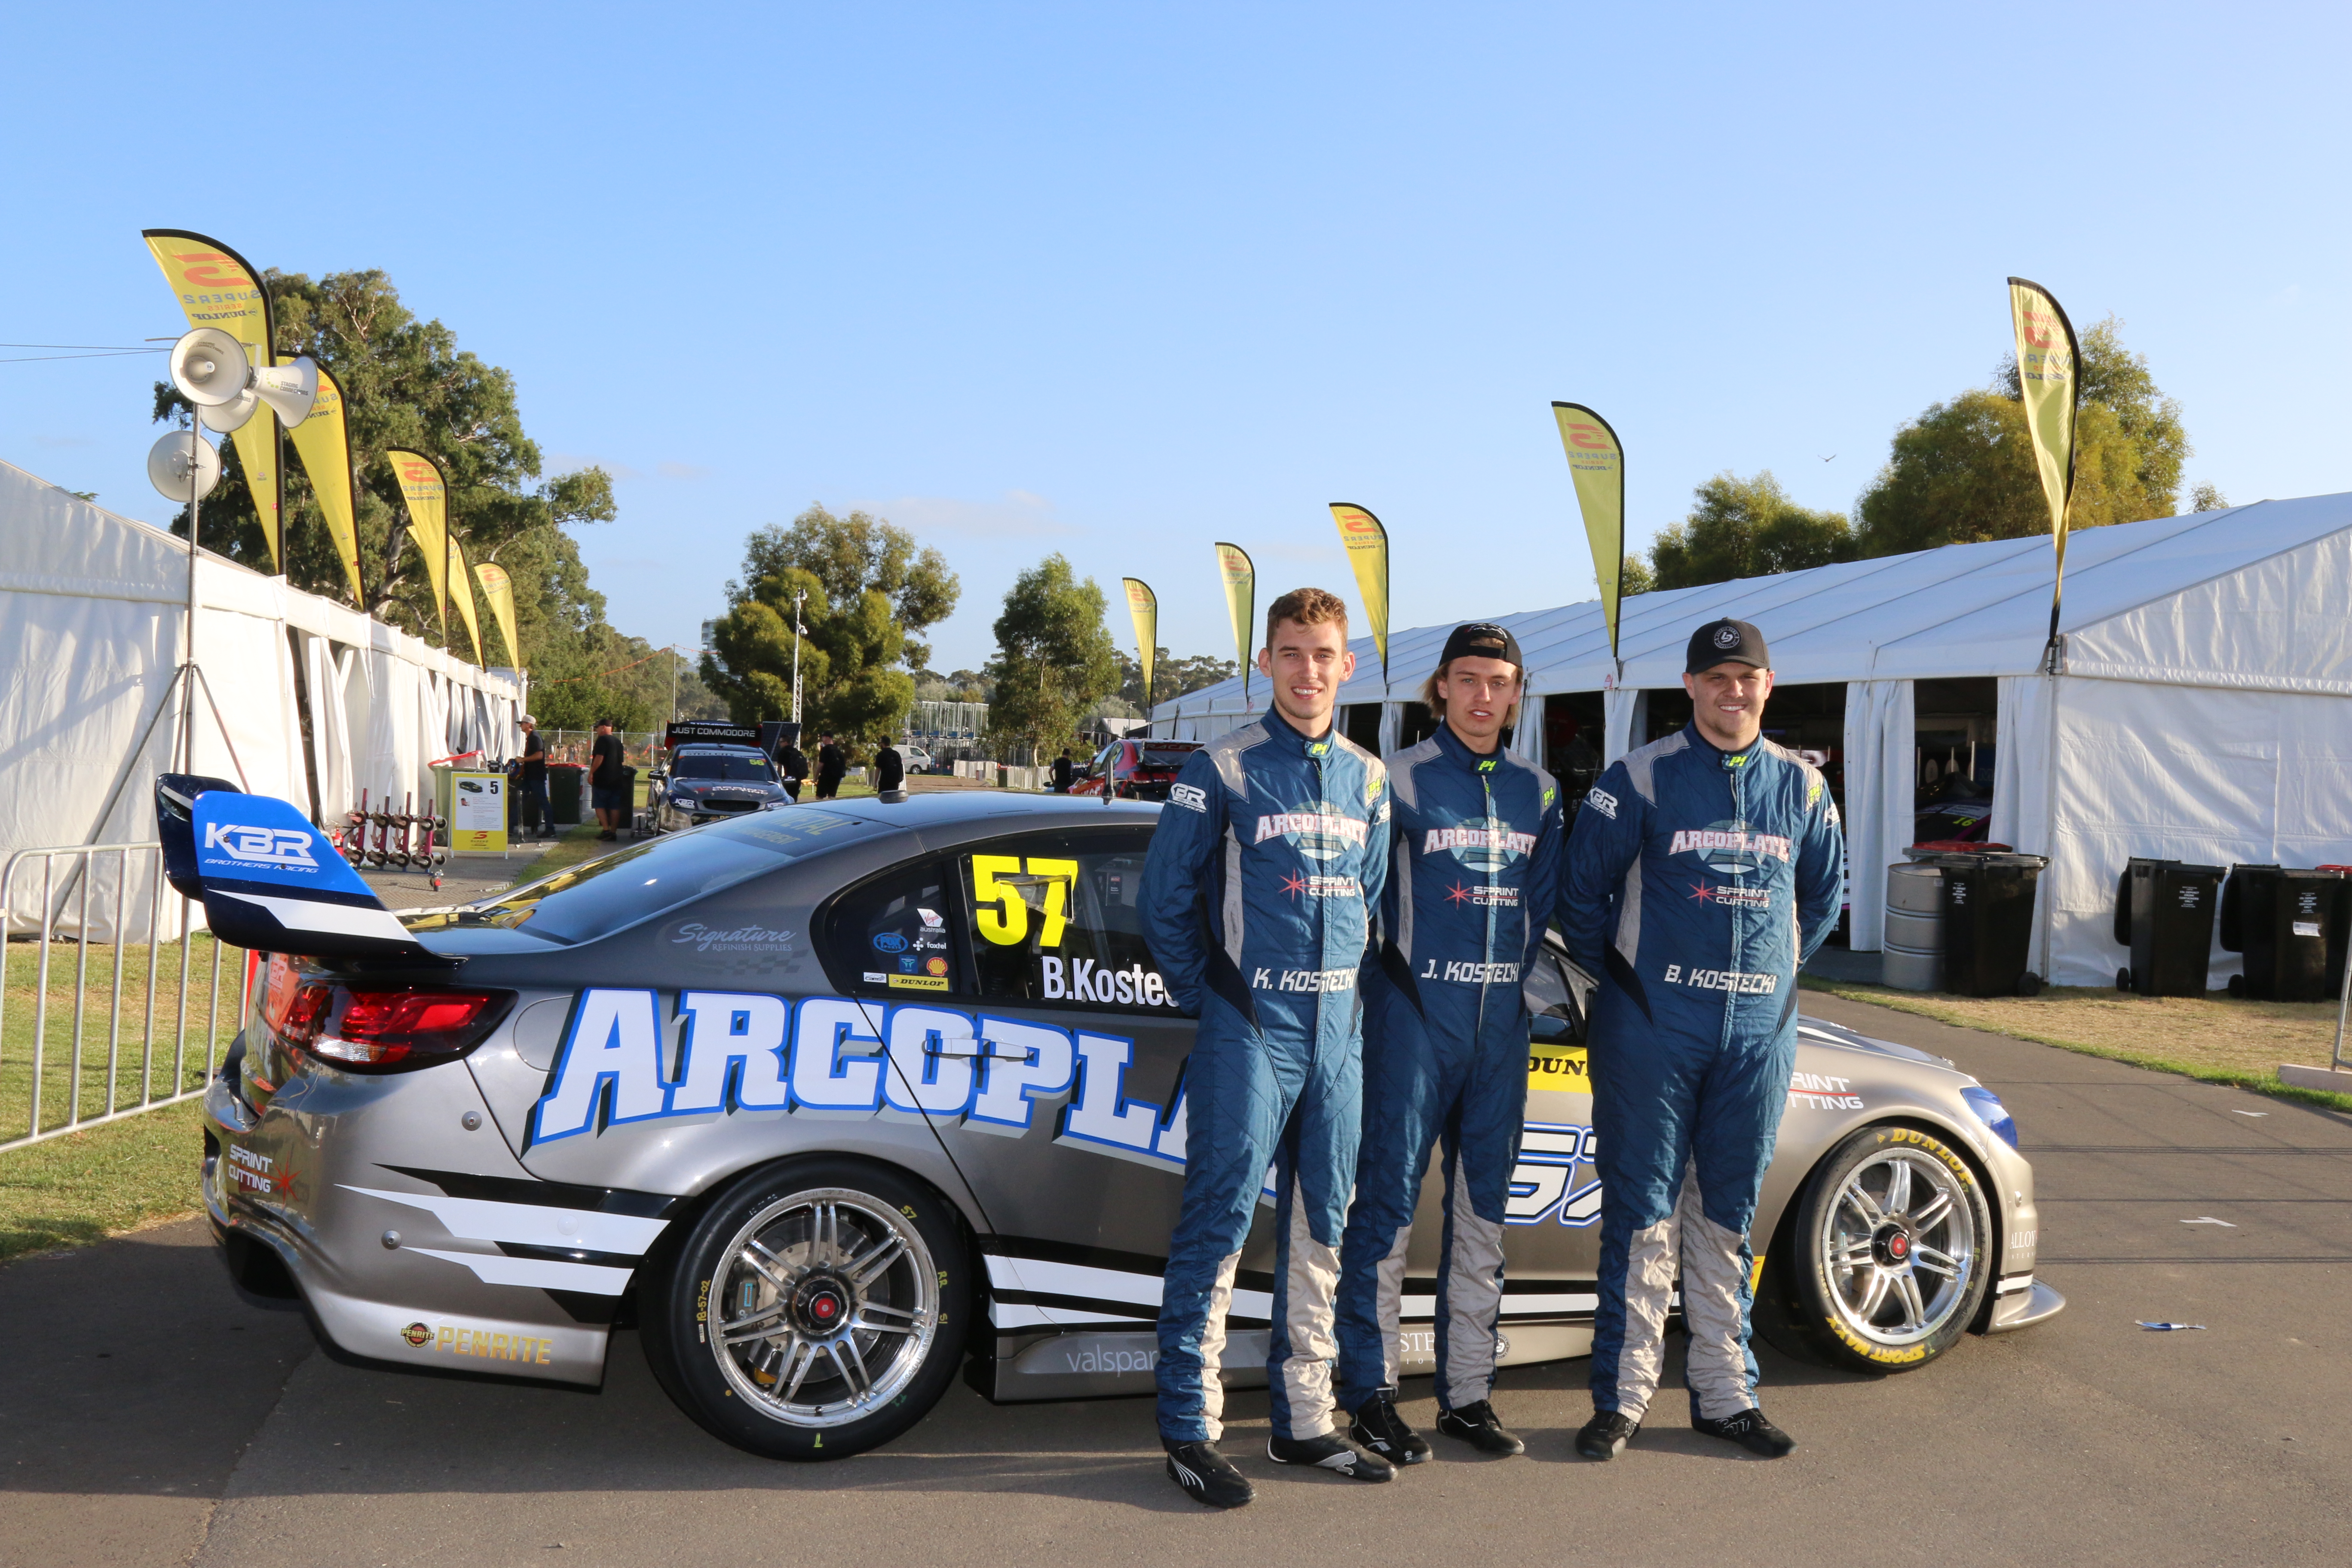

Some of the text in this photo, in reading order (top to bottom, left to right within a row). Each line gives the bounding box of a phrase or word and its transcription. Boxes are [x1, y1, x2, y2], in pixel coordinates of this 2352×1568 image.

[697, 728, 756, 737] COMMODORE
[490, 781, 499, 794] 5
[675, 798, 695, 809] KBR
[1254, 813, 1369, 850] ARCOPLATE
[1952, 817, 1977, 826] 16
[204, 822, 319, 867] KBR
[1423, 828, 1537, 860] ARCOPLATE
[1668, 830, 1792, 863] ARCOPLATE
[204, 858, 271, 870] BROTHERS
[1309, 876, 1355, 886] SPRINT
[972, 854, 1078, 947] 57
[1309, 888, 1355, 897] CUTTING
[1473, 897, 1518, 906] CUTTING
[924, 912, 940, 925] Virgin
[671, 923, 796, 951] Signature
[880, 935, 902, 945] FOX
[927, 941, 946, 949] foxtel
[712, 943, 751, 952] REFINISH
[1253, 967, 1358, 993] K. KOSTECKI
[1421, 959, 1523, 984] J. KOSTECKI
[1664, 964, 1778, 994] B. KOSTECKI
[1528, 1056, 1587, 1076] DUN
[1790, 1072, 1850, 1092] RINT
[1787, 1092, 1864, 1110] TTING
[229, 1143, 273, 1173] SPRINT
[1891, 1128, 1973, 1185] DUNLOP
[228, 1164, 271, 1193] CUTTING
[900, 1205, 918, 1219] 57
[2009, 1230, 2036, 1249] ALLOY
[937, 1271, 947, 1288] RR
[696, 1279, 710, 1321] 18-57-02
[401, 1328, 435, 1340] PENRITE
[920, 1327, 934, 1354] RACER
[1400, 1332, 1435, 1352] STE
[1825, 1313, 1925, 1364] SPORT MAXX
[435, 1325, 553, 1365] PENRITE
[1066, 1344, 1158, 1377] valspar
